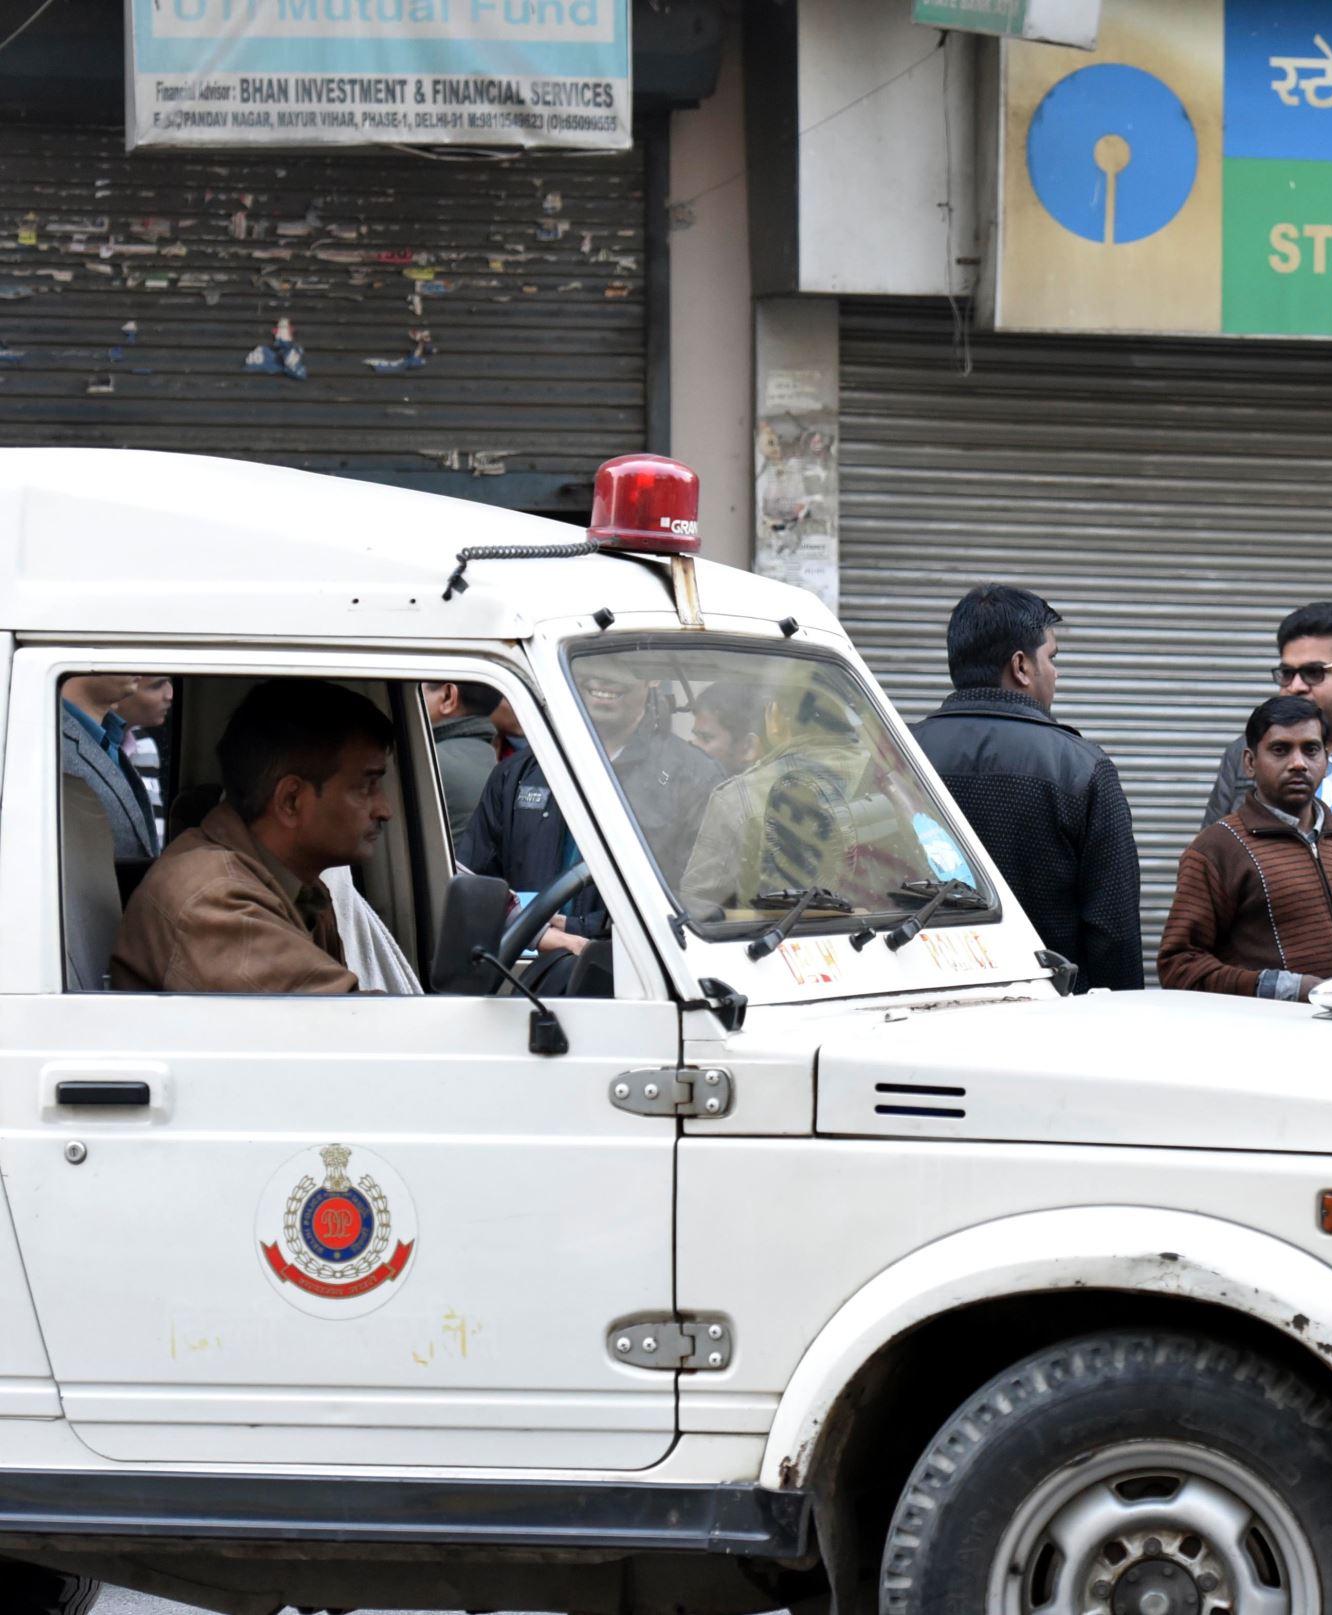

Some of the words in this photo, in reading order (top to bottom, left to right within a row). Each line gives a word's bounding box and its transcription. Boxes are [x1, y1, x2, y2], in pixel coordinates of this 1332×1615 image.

[239, 78, 289, 103] BHAN
[295, 78, 408, 104] INVESTMENT
[414, 80, 425, 102] &
[432, 80, 526, 105] FINANCIAL
[530, 81, 614, 108] SERVICES
[231, 111, 272, 130] NAGAR,
[277, 112, 317, 128] MAYUR
[321, 112, 358, 131] VIHAR,
